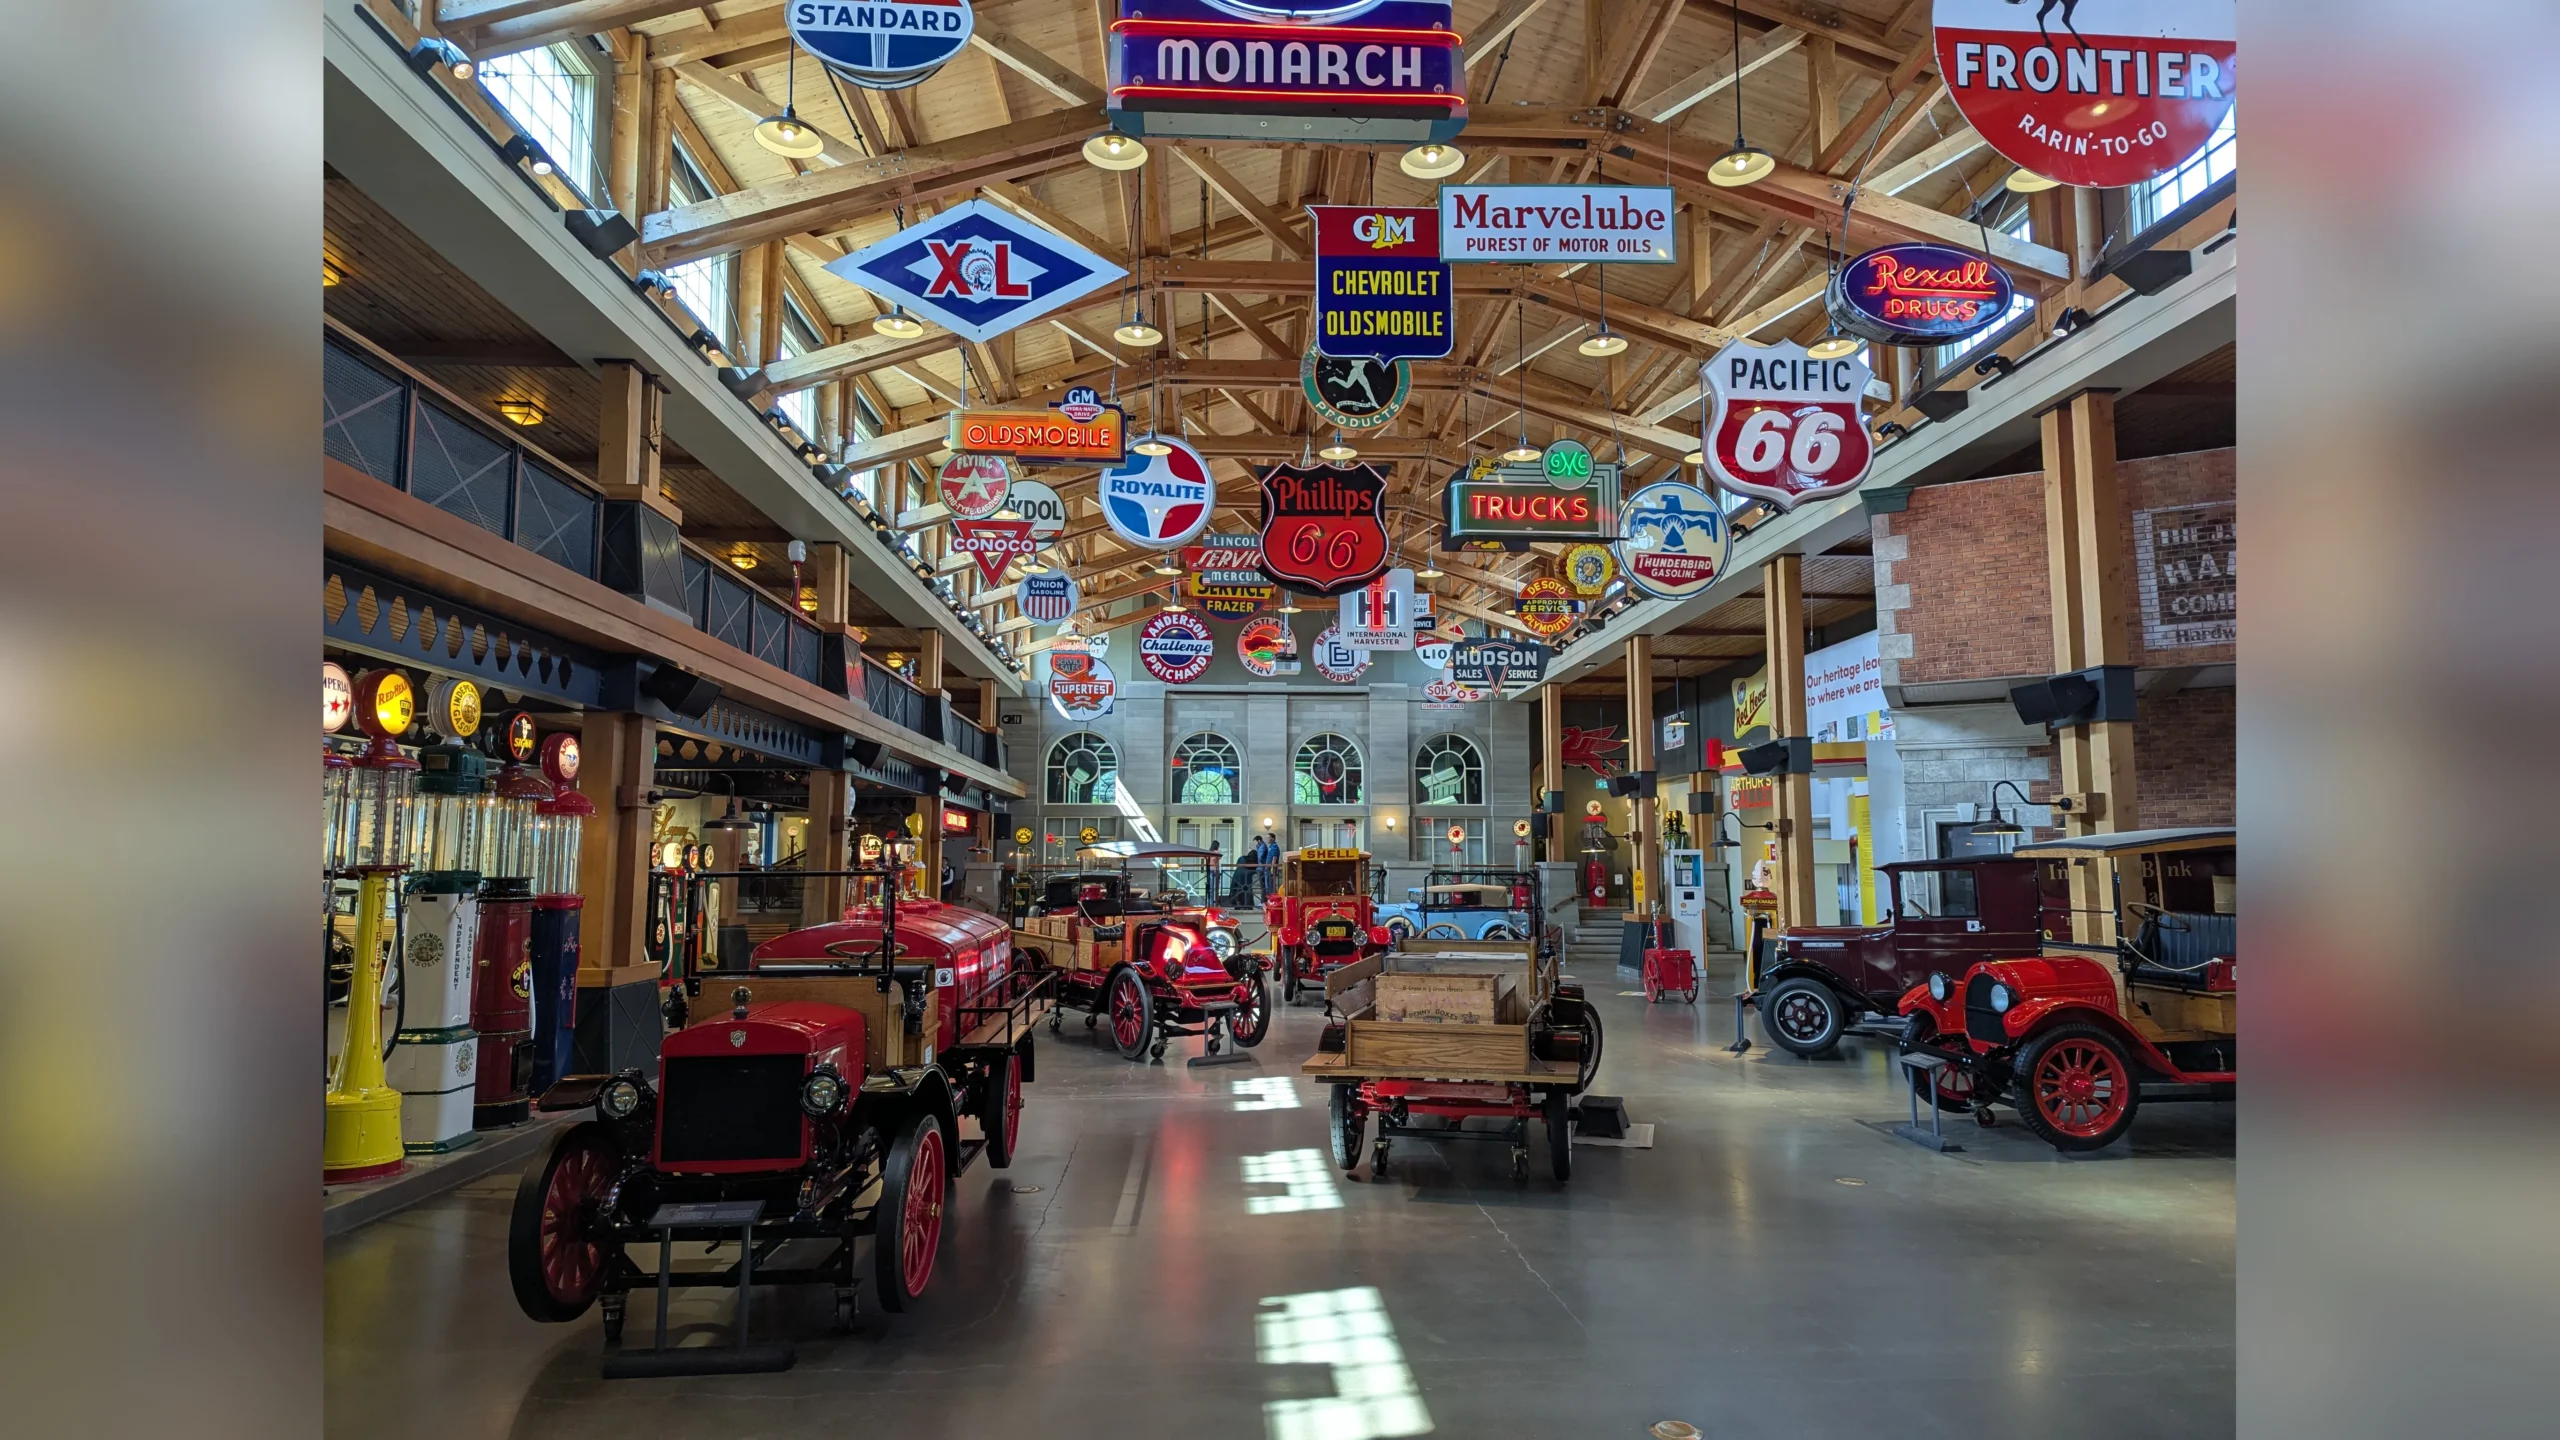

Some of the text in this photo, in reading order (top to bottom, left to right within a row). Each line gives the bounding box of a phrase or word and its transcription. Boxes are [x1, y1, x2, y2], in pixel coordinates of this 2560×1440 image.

[797, 4, 962, 32] STANDARD
[1157, 39, 1421, 87] MONARCH
[1956, 43, 2221, 98] FRONTIER
[2018, 113, 2168, 156] RARIN'-TO-GO
[1454, 194, 1665, 230] Marvelube
[1353, 214, 1415, 242] GM
[1467, 238, 1651, 253] PUREST OF MOTOR OILS
[928, 242, 1029, 296] XL
[1868, 255, 1996, 291] Rexall
[1333, 270, 1440, 296] CHEVROLET
[1886, 299, 1977, 320] DRUGS
[1327, 310, 1443, 336] OLDSMOBILE
[1731, 358, 1851, 392] PACIFIC
[1068, 389, 1094, 405] GM
[967, 425, 1111, 447] OLDSMOBILE
[1735, 410, 1845, 473] 66
[956, 454, 993, 470] FLYING
[1550, 452, 1589, 476] GMC
[1112, 479, 1205, 500] ROYALITE
[1272, 476, 1373, 520] Phillips
[1009, 494, 1062, 520] YDOL
[1471, 495, 1589, 519] TRUCKS
[953, 538, 1034, 552] CONOCO
[1213, 536, 1262, 547] LINCOL
[1289, 523, 1362, 571] 66
[1192, 549, 1263, 568] SERVIC
[1638, 553, 1712, 570] THUNDERBIRD
[1651, 568, 1696, 579] GASOLINE
[1031, 580, 1064, 589] UNION
[1527, 582, 1541, 595] DE
[1542, 580, 1566, 595] SOTO
[1206, 600, 1254, 613] FRAZER
[1148, 614, 1208, 639] ANDERSON
[1414, 620, 1432, 628] ERVICE
[1524, 614, 1571, 632] PLYMOUTH
[1142, 639, 1211, 654] Challenge
[1316, 632, 1328, 647] BE
[1060, 664, 1080, 672] SALES
[1146, 654, 1207, 680] PRICHARD
[1245, 660, 1272, 674] SERV
[1455, 650, 1537, 666] HUDSON
[1317, 662, 1367, 681] PRODUCTS
[1456, 669, 1538, 679] SALES SERVICE
[1806, 674, 1822, 688] Our
[1823, 663, 1861, 683] heritage
[1054, 681, 1112, 694] SUPERTEST
[1427, 685, 1449, 696] SOH
[1807, 679, 1880, 707] to where we are
[1736, 682, 1767, 732] Red Head
[1306, 849, 1355, 859] SHELL
[408, 932, 444, 951] INDEPENDENT
[407, 953, 444, 968] GASOLINE
[453, 917, 463, 990] INDEPENDENT
[1408, 1009, 1431, 1018] PENNY
[1435, 1008, 1458, 1020] BOXES
